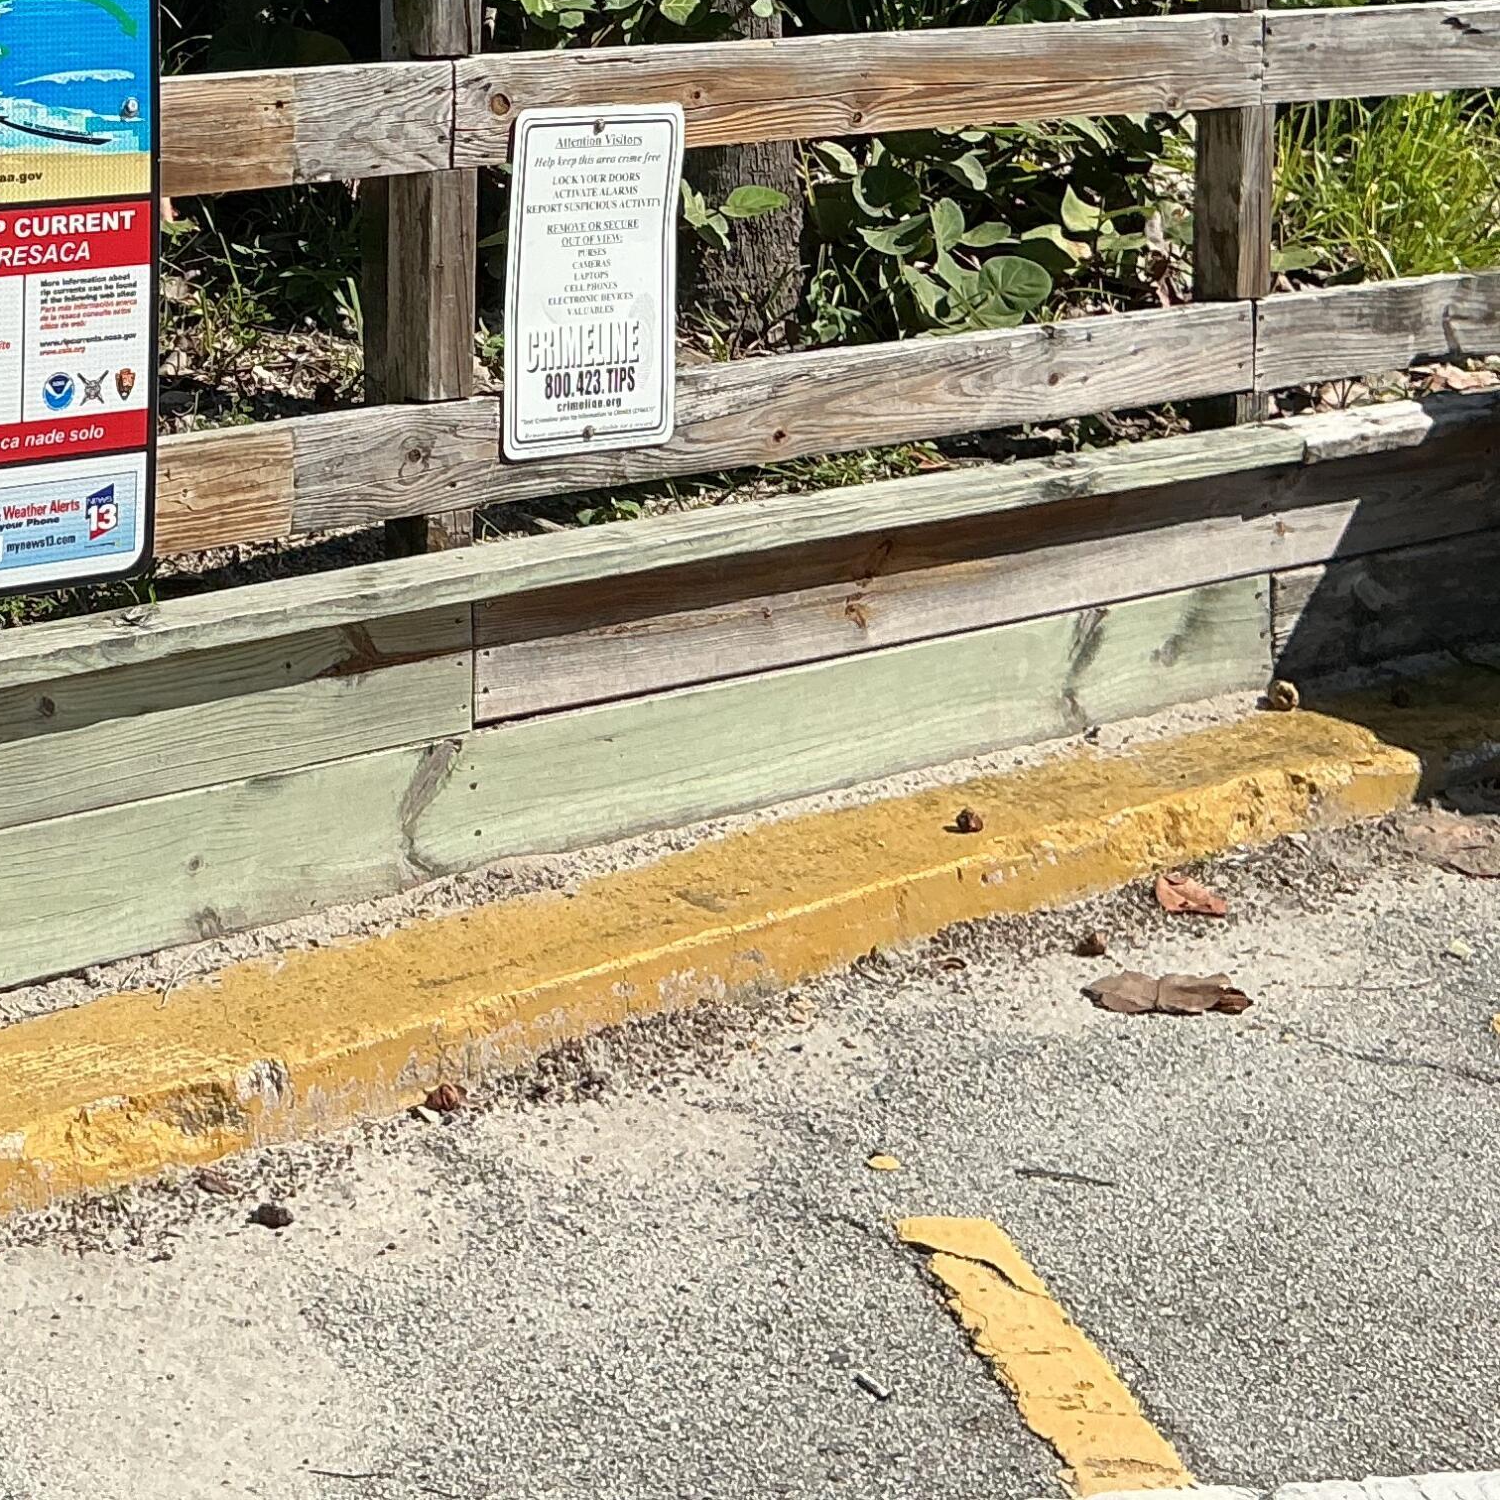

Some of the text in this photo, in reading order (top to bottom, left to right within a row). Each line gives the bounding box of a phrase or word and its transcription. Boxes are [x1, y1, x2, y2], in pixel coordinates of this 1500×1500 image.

[556, 134, 642, 149] Attention Visitors
[552, 173, 640, 185] LOCK YOUR DOORS
[526, 198, 661, 214] REPORT SUSPICIOUS ACTIVITY
[14, 210, 136, 238] CURRENT
[526, 321, 639, 373] CRIMELINE
[545, 366, 635, 400] 800.423.TIPS
[557, 398, 621, 413] crimeline.org
[24, 430, 64, 447] nade
[69, 424, 104, 442] solo
[3, 503, 47, 520] Weather
[50, 499, 80, 513] Alerts
[88, 504, 117, 531] 13
[0, 522, 22, 531] your
[27, 517, 60, 527] Phone
[7, 534, 76, 554] mynews13.com
